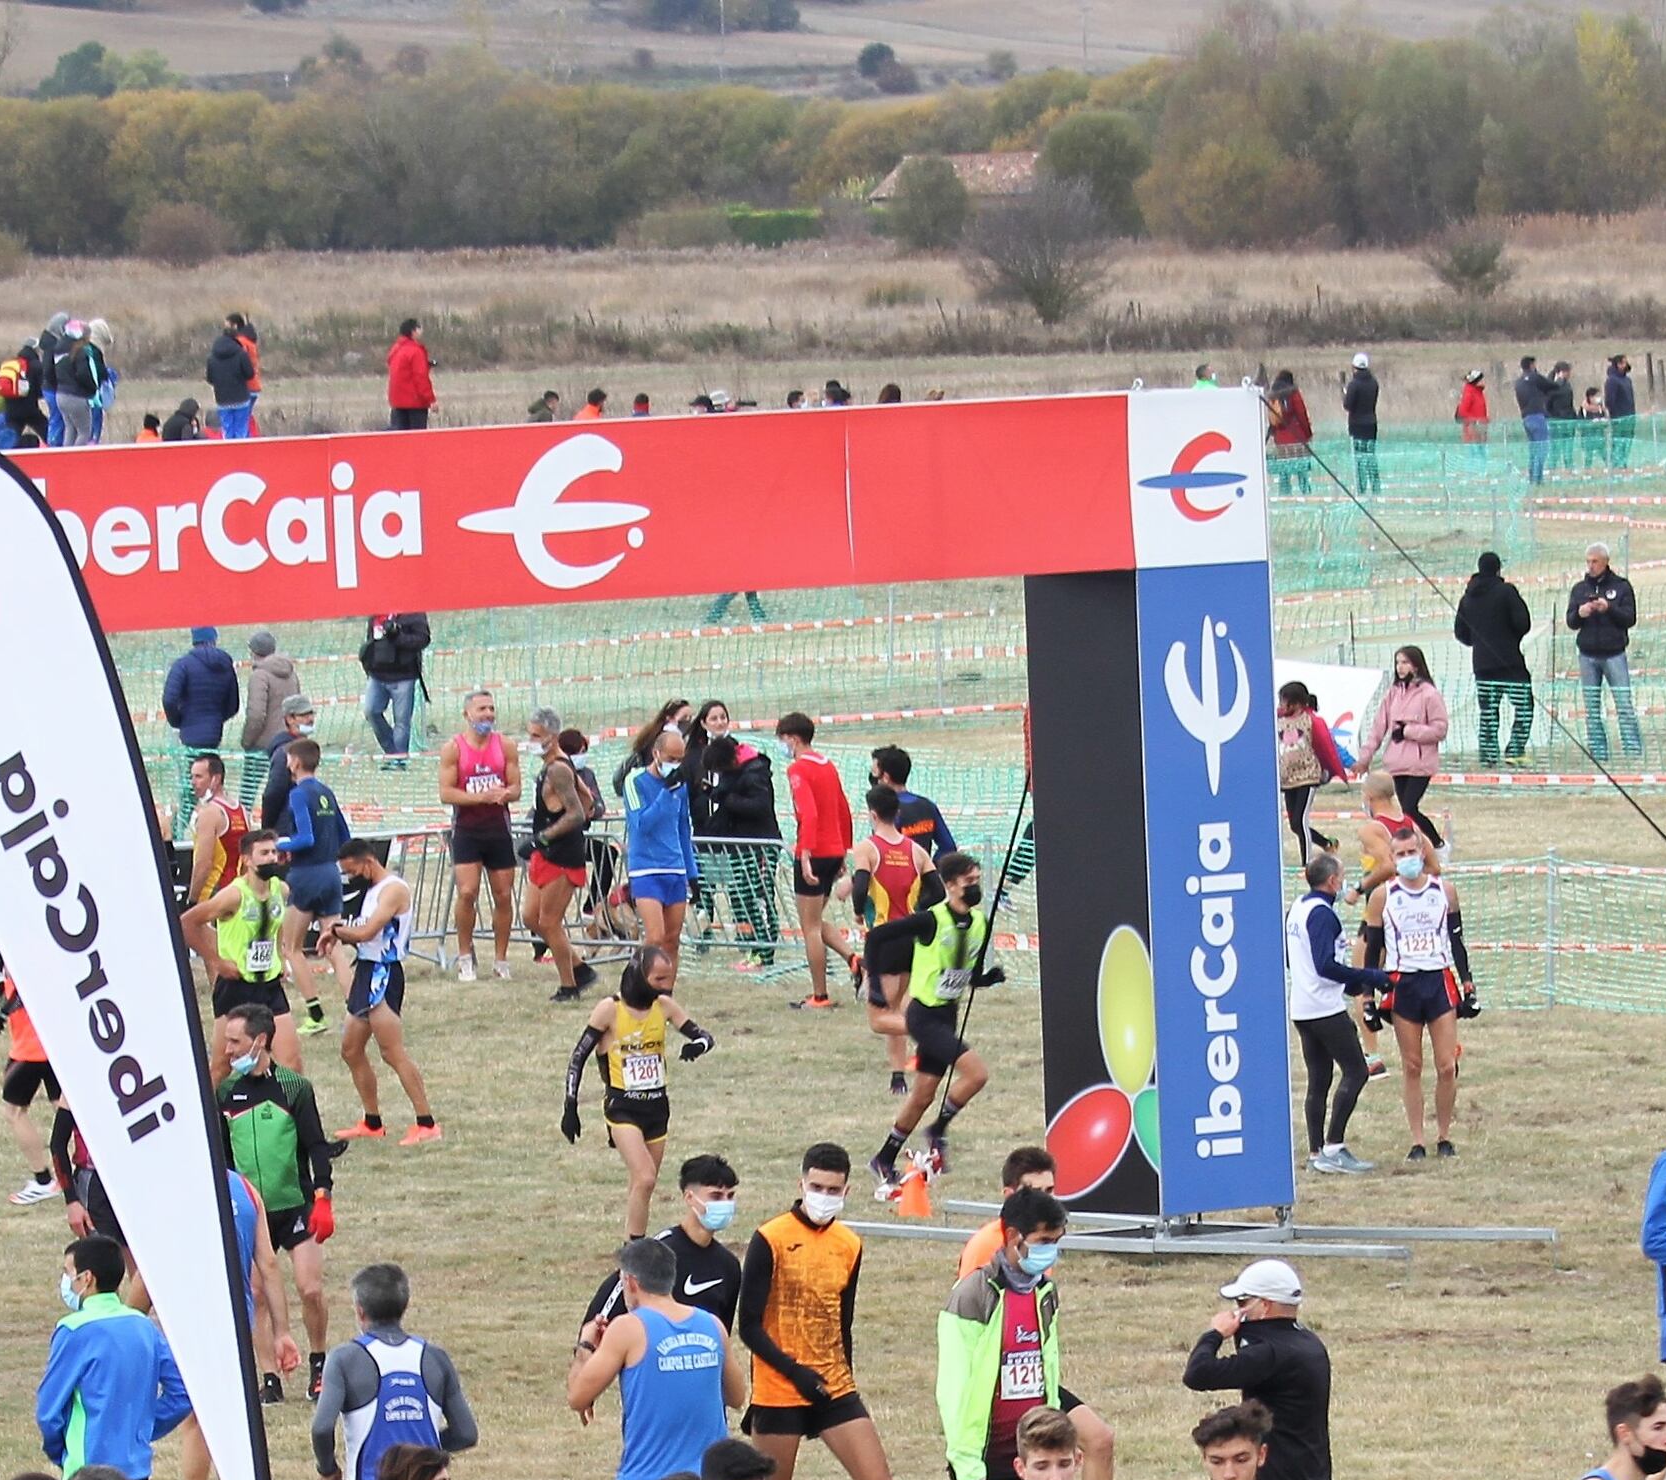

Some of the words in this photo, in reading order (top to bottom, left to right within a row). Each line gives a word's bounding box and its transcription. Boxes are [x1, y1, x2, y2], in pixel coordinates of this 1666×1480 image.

[1404, 938, 1436, 953] 1221
[1185, 822, 1247, 1160] iberCaja
[629, 1064, 660, 1081] 1201
[684, 1354, 693, 1370] DE
